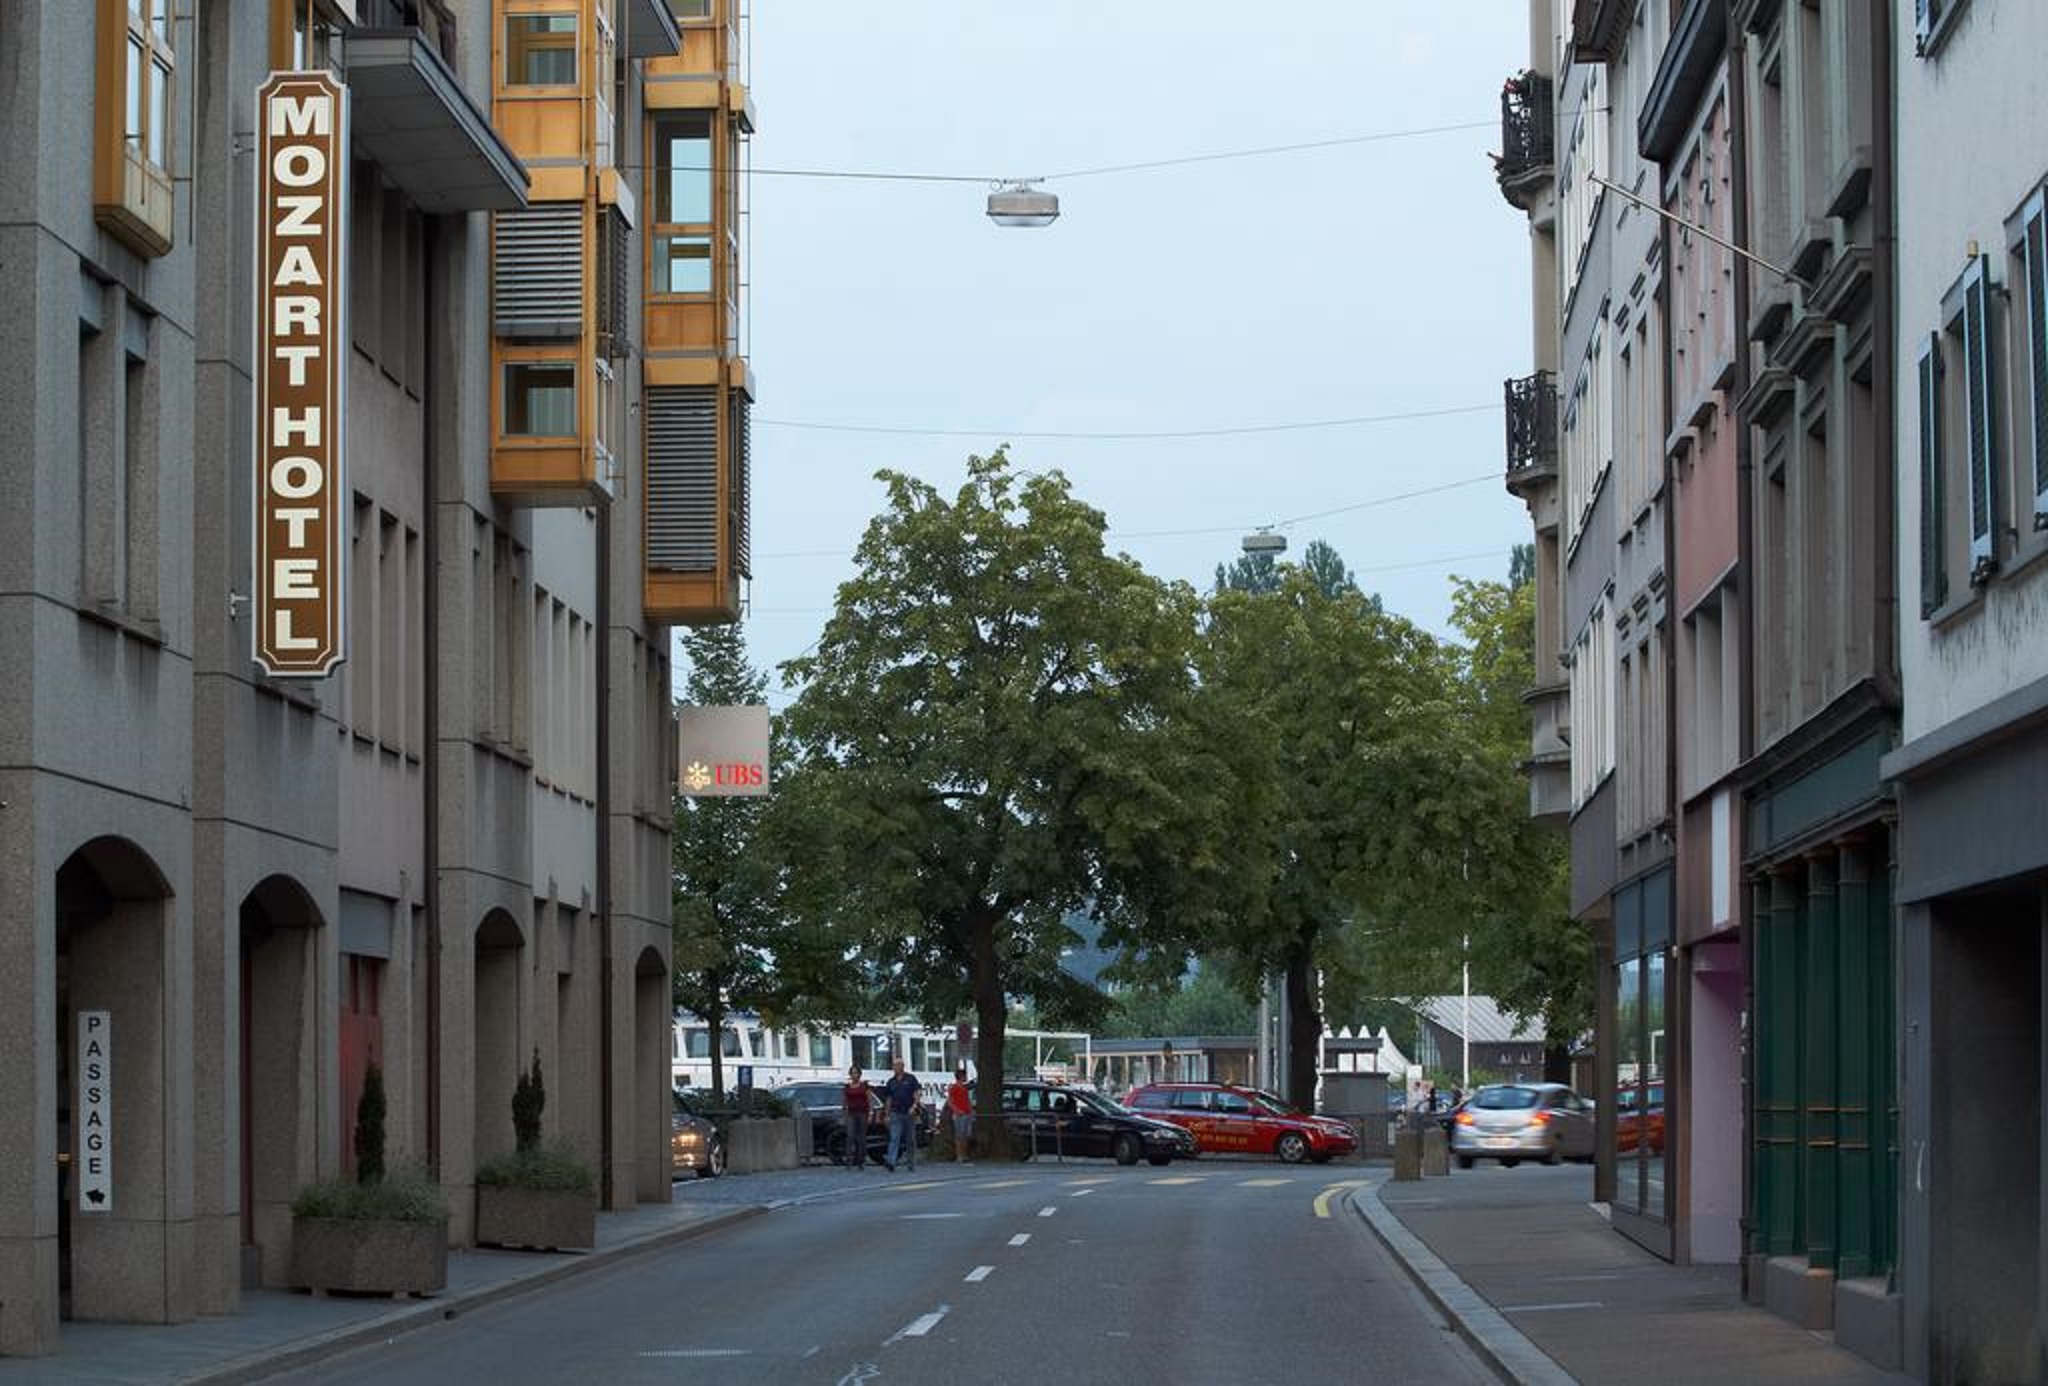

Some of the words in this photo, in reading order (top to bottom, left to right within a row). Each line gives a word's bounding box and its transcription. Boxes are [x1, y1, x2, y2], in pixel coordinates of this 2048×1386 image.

[270, 96, 331, 386] MOZART
[269, 407, 323, 649] HOTEL
[715, 764, 762, 786] UBS
[86, 1016, 103, 1175] PASSAGE
[876, 1036, 889, 1052] 2
